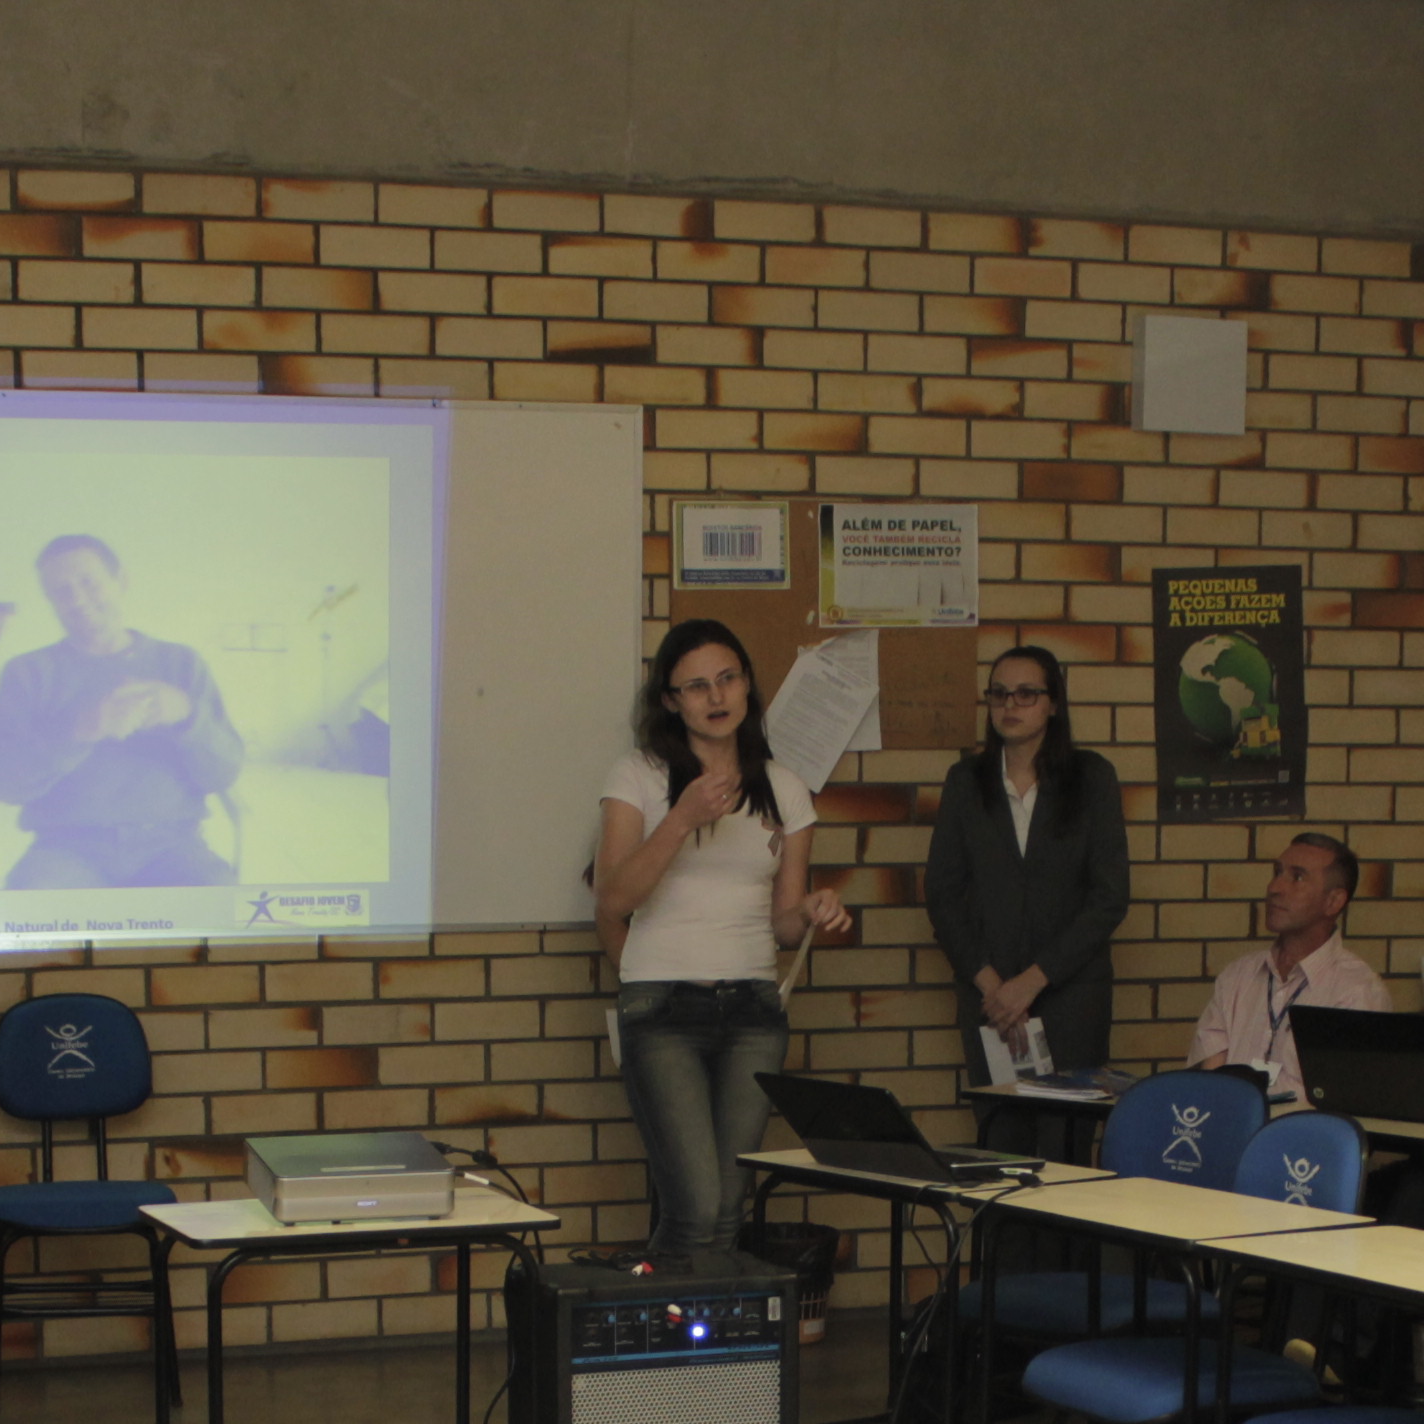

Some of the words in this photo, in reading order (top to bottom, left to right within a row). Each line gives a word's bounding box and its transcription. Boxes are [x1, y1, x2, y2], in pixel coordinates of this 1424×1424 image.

[842, 517, 882, 530] ALÉM
[888, 519, 906, 531] DE
[912, 519, 962, 533] PAPEL,
[842, 534, 868, 543] VOCÊ
[873, 535, 914, 543] TAMBÉM
[918, 535, 961, 543] RECICLA
[842, 546, 962, 557] CONHECIMENTO?
[1168, 579, 1257, 595] PEQUENAS
[1169, 594, 1226, 612] AÇÕES
[1230, 594, 1286, 609] FAZEM
[1169, 612, 1182, 627] A
[1185, 610, 1281, 627] DIFERENÇA
[4, 919, 59, 933] Natural
[60, 919, 80, 932] de
[86, 918, 124, 931] Nova
[127, 917, 175, 930] Trento
